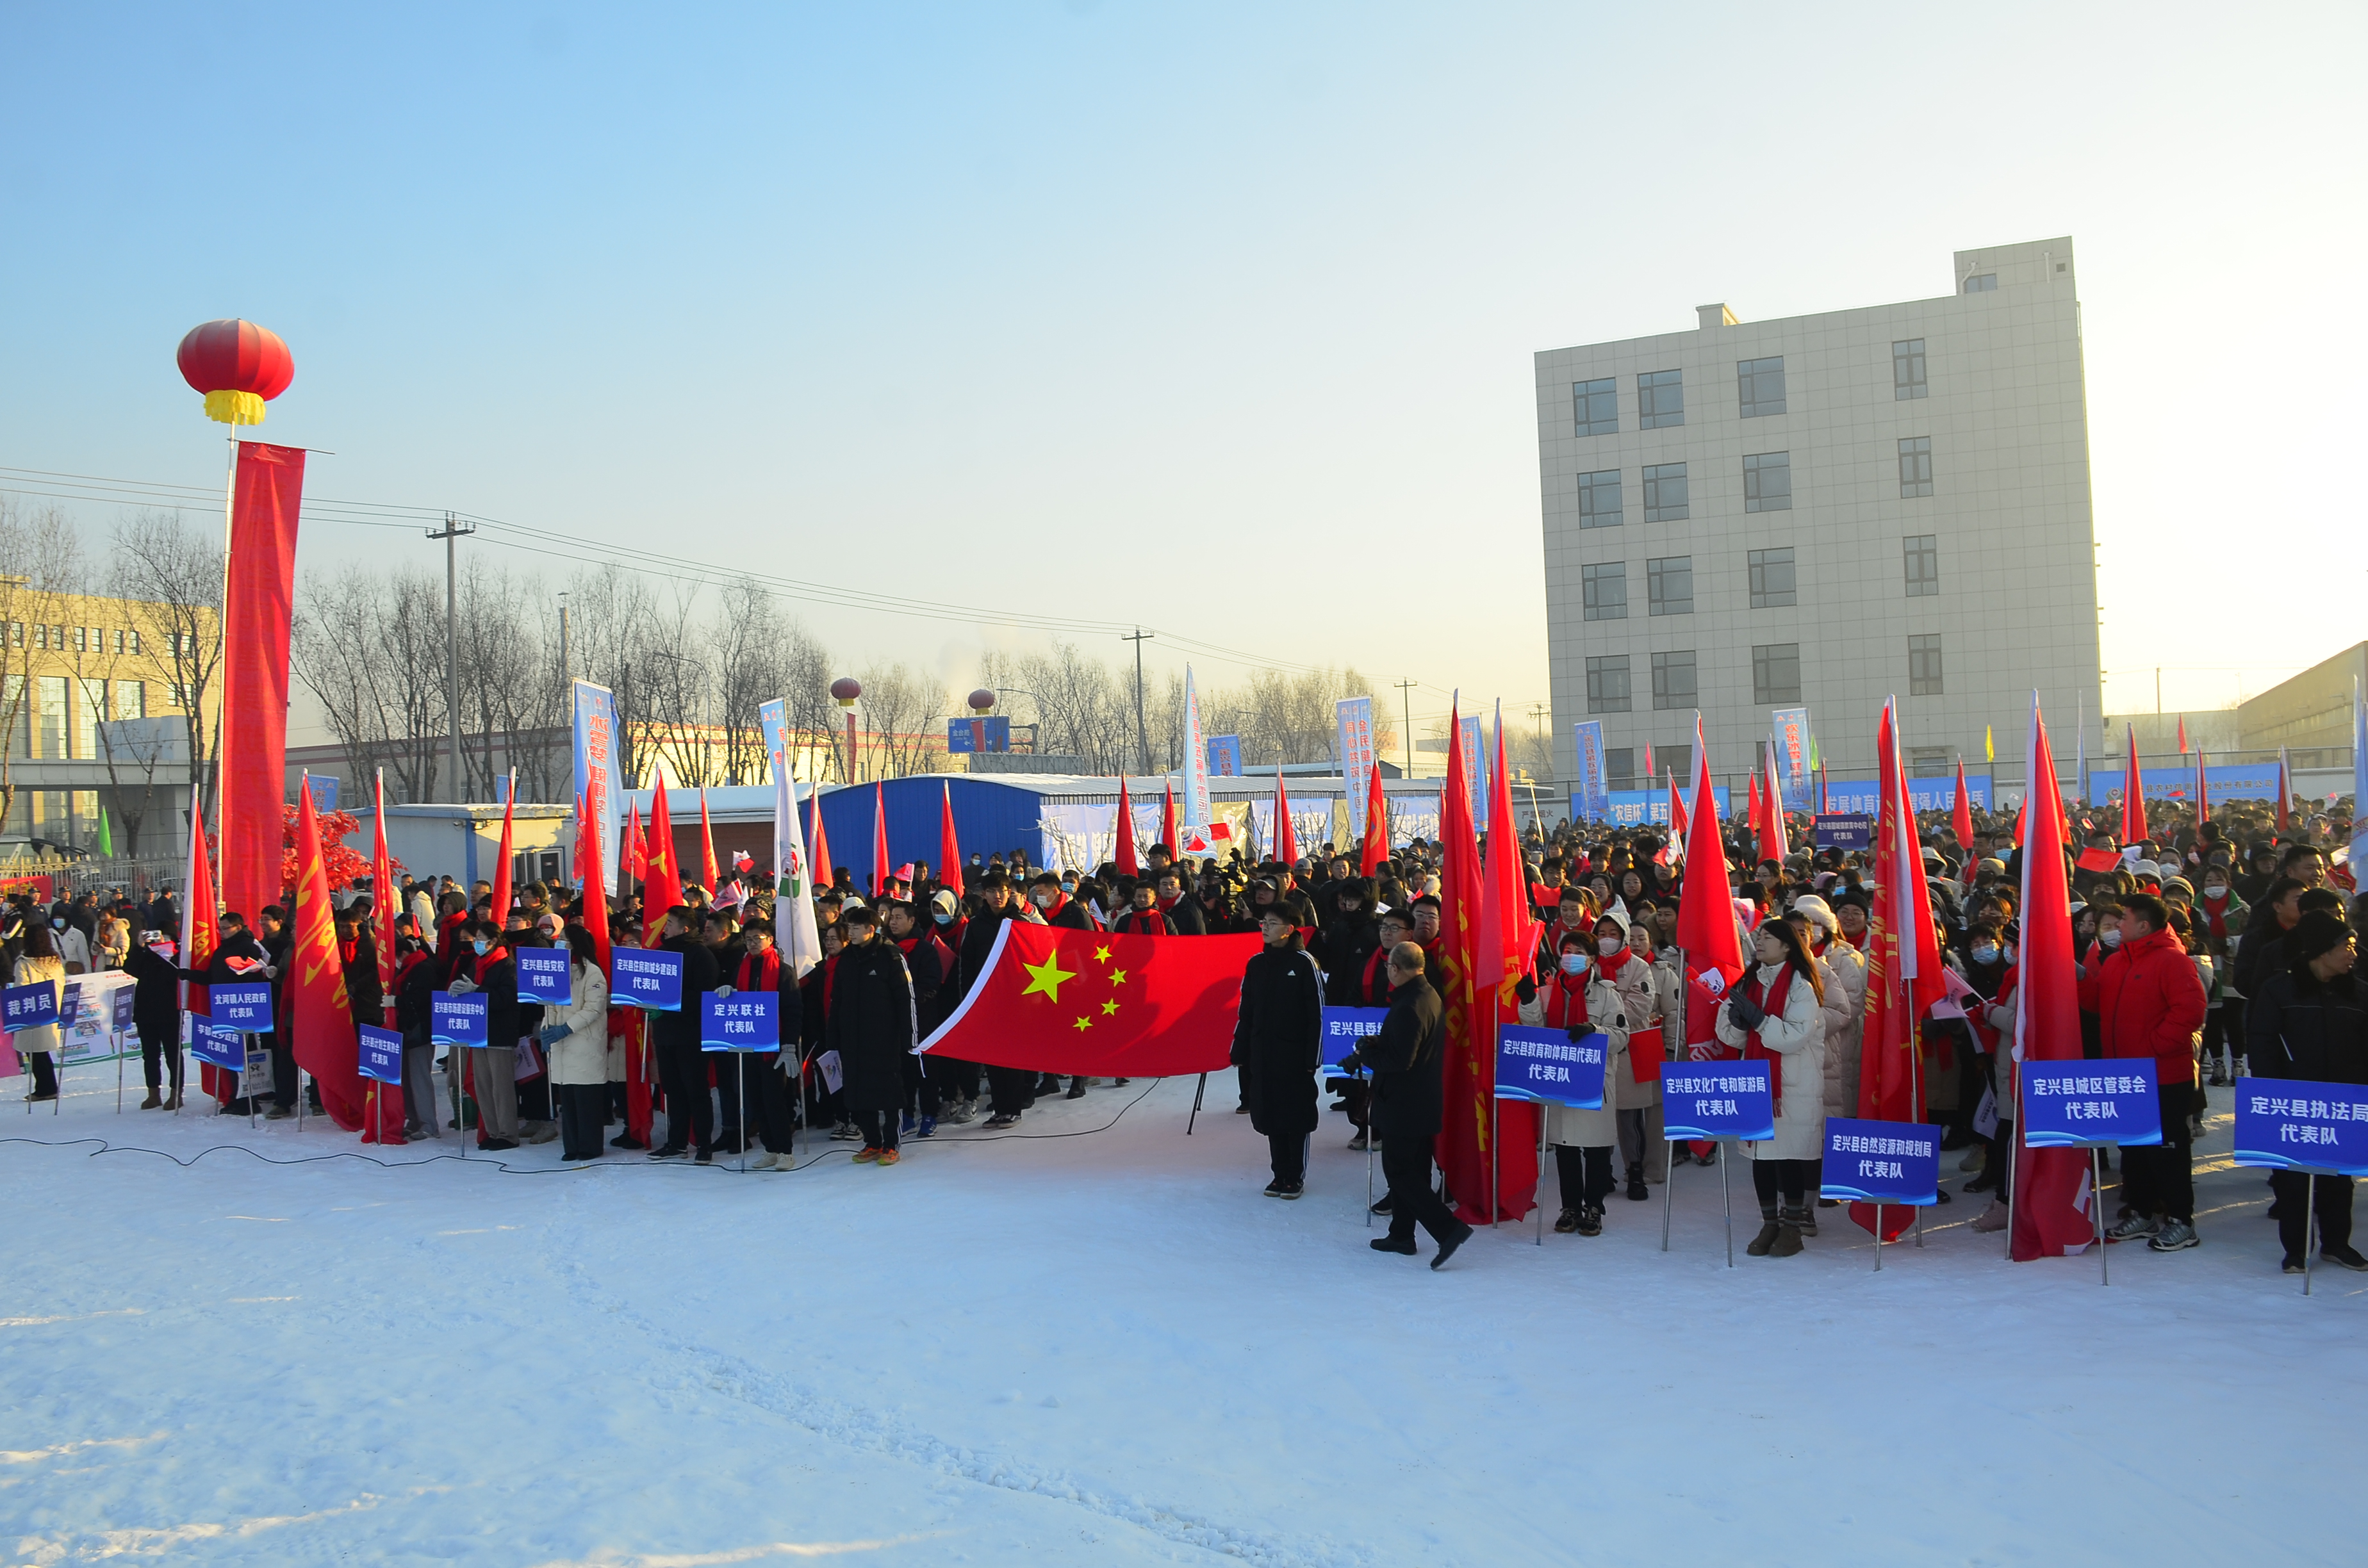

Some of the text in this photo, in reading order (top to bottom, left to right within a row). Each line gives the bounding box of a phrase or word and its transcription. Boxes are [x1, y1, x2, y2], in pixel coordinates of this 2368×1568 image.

[1785, 724, 1801, 760] 欢乐冰雪
[1345, 721, 1365, 824] 同心共筑中国梦
[522, 958, 565, 972] 定兴县委党校
[617, 958, 677, 977] 定兴县住房和城乡建设局
[532, 975, 555, 988] 代表队
[632, 977, 661, 991] 代表队
[7, 993, 51, 1017] 裁判员
[214, 993, 267, 1004] 北河镇人民政府
[229, 1008, 254, 1018] 代表队
[714, 1004, 766, 1017] 定兴联社
[448, 1018, 470, 1030] 代表队
[725, 1021, 755, 1033] 代表队
[207, 1040, 229, 1054] 代表队
[1503, 1039, 1601, 1065] 定兴县教育和体育局代表队
[372, 1052, 388, 1066] 代表队
[1529, 1063, 1570, 1082] 代表队
[1666, 1076, 1766, 1094] 定兴县文化广电和旅游局
[2033, 1075, 2146, 1096] 定兴县城区管委会
[1695, 1099, 1738, 1116] 代表队
[2065, 1101, 2119, 1120] 代表队
[2250, 1096, 2368, 1122] 定兴县执法局
[2280, 1123, 2339, 1145] 代表队
[1832, 1134, 1932, 1157] 定兴县自然资源和规划局
[1859, 1159, 1903, 1179] 代表队
